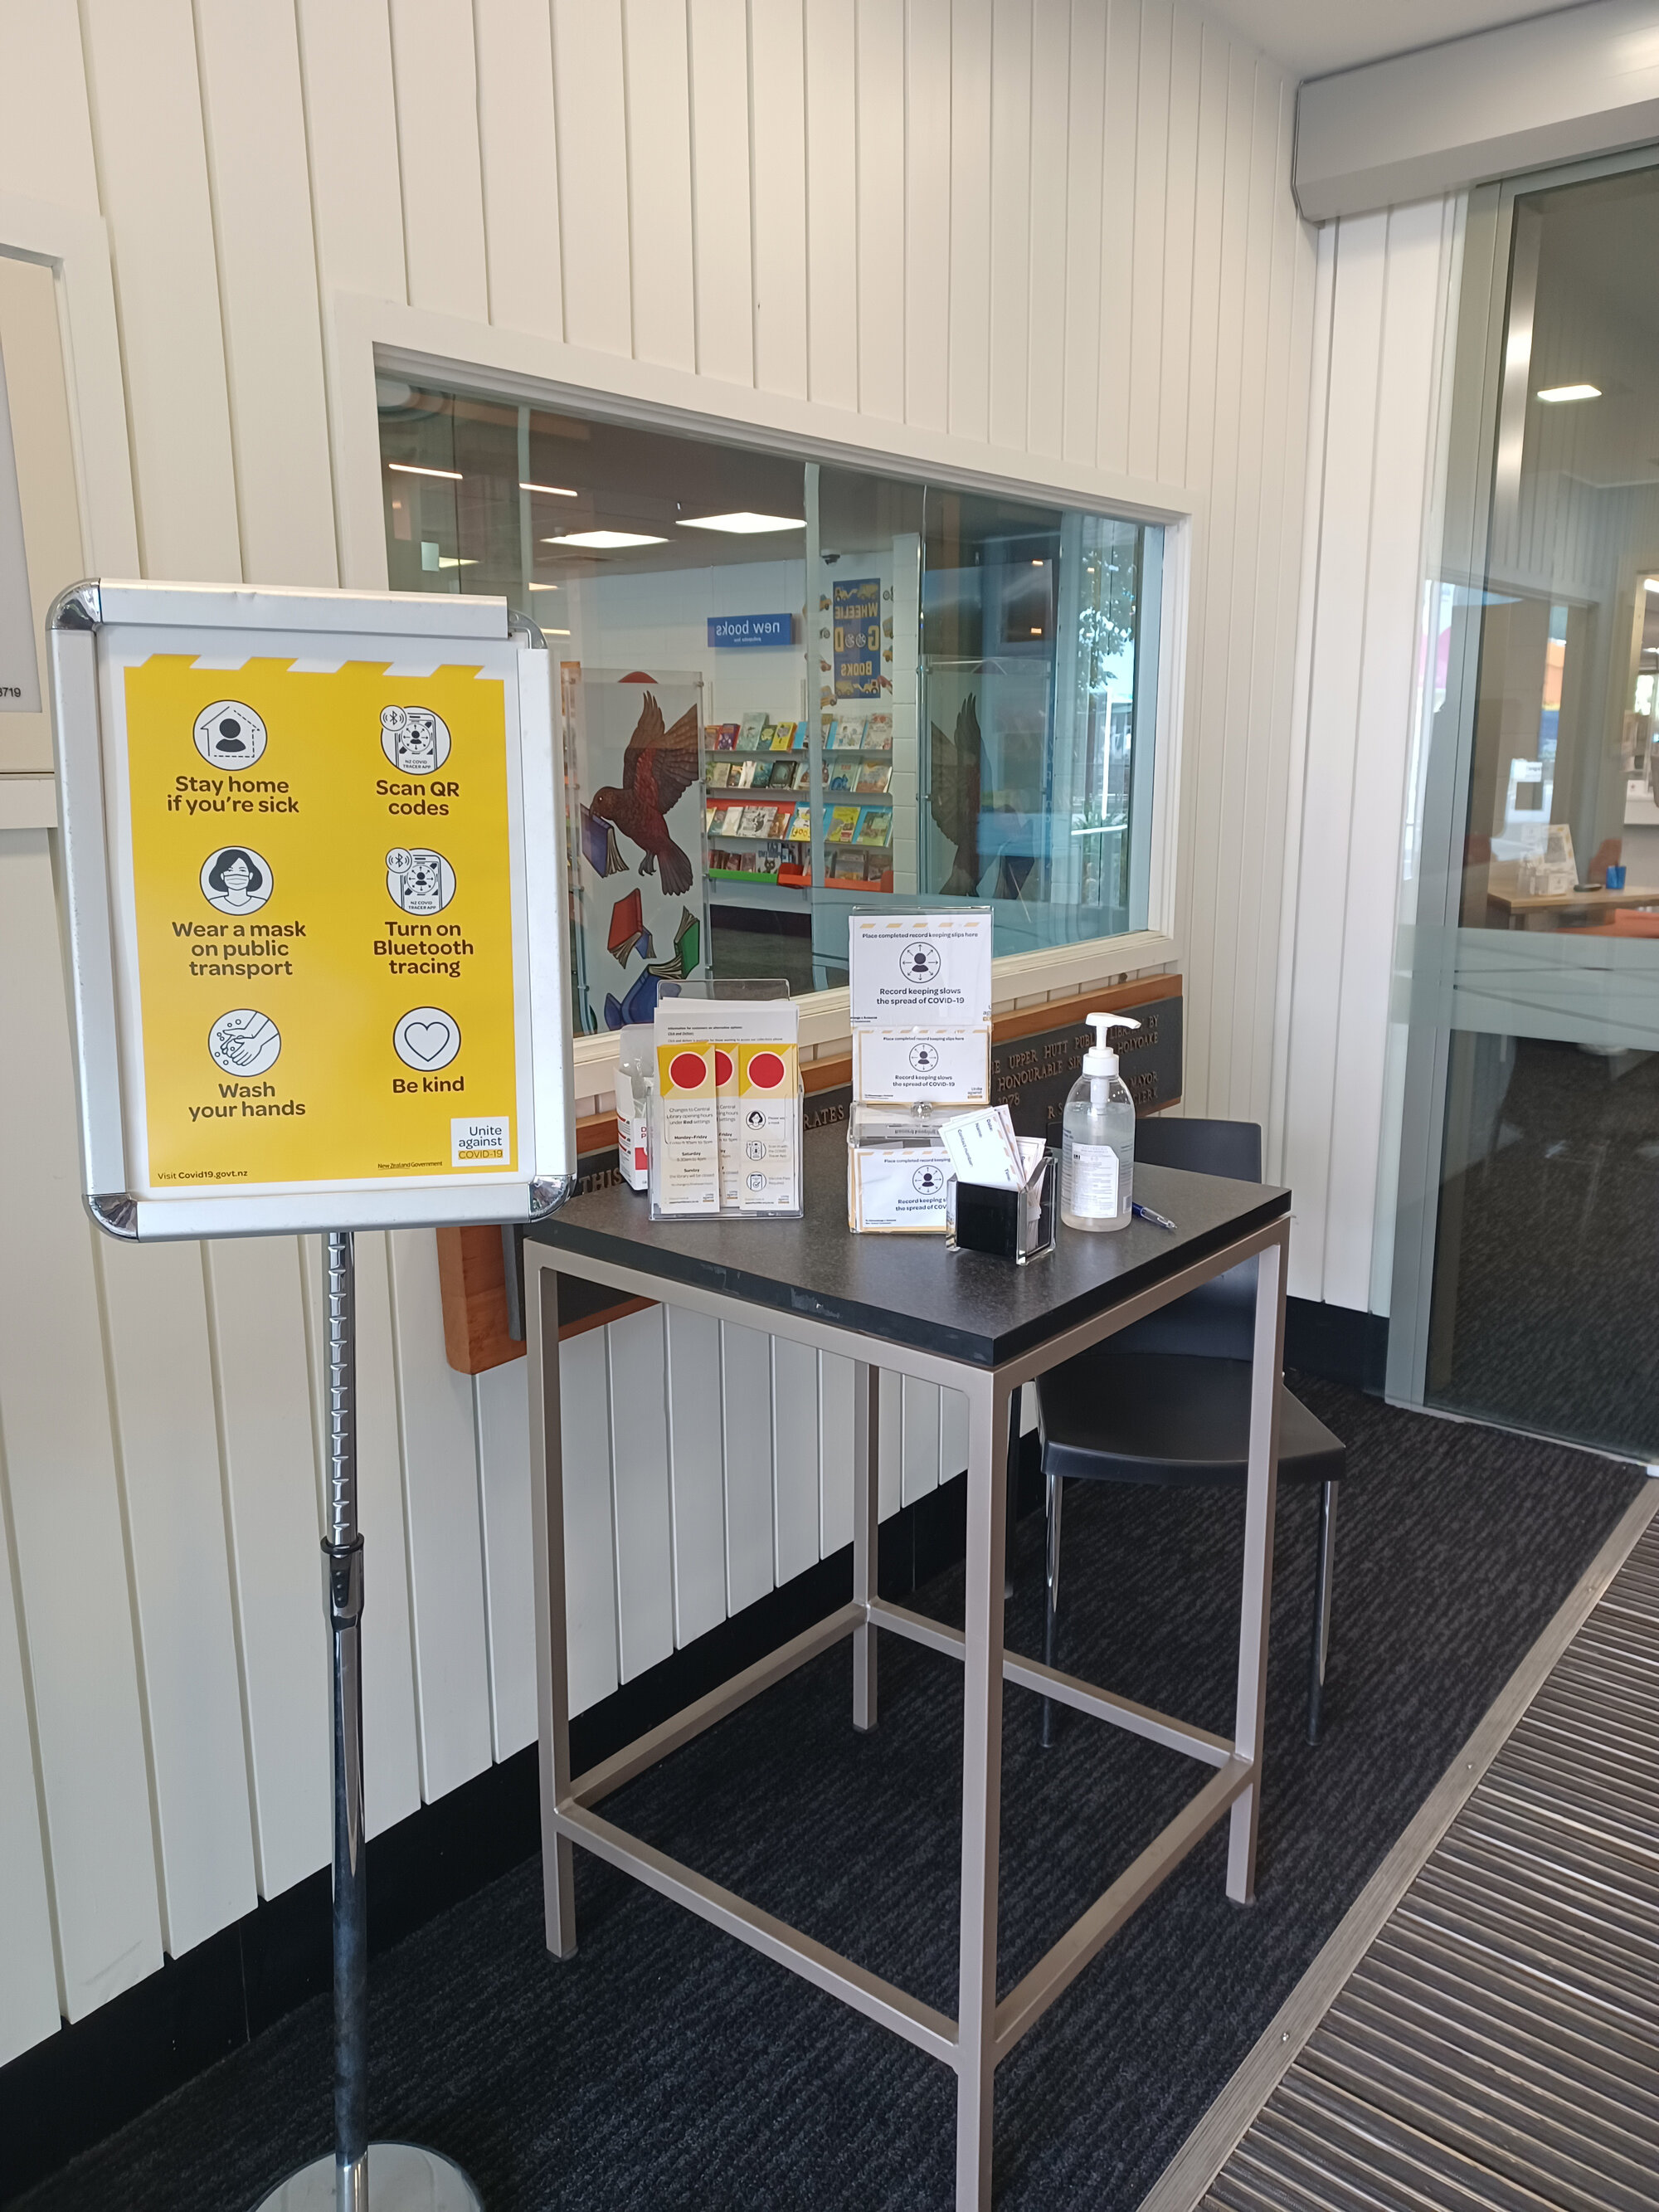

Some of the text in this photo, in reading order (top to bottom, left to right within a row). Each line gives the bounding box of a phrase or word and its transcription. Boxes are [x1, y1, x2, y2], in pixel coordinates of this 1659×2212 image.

[175, 775, 289, 797] Stay home
[376, 779, 460, 797] Scan QR
[167, 794, 299, 816] if you're sick
[388, 799, 450, 816] codes
[172, 920, 306, 938] Wear a mask
[384, 921, 461, 937] Turn on
[191, 939, 289, 961] on public
[373, 938, 474, 955] Bluetooth
[188, 960, 293, 980] transport
[388, 957, 461, 978] tracing
[908, 987, 939, 996] keeping
[890, 997, 917, 1006] spread
[997, 1060, 1063, 1092] HONOURABLE
[1068, 1055, 1082, 1070] SIR
[1117, 1031, 1159, 1055] HOLYOAKE
[392, 1075, 465, 1094] Be kind
[1130, 1071, 1159, 1088] MAYOR
[218, 1081, 275, 1099] Wash
[187, 1099, 306, 1123] your hands
[578, 1167, 624, 1195] THIS
[803, 1104, 844, 1129] RATES
[1009, 1050, 1039, 1069] UPPER
[1044, 1040, 1068, 1060] HUTT
[1075, 1032, 1095, 1050] PUBL
[1148, 1015, 1160, 1029] BY
[469, 1125, 502, 1137] Unite
[957, 1128, 967, 1148] Contact
[458, 1136, 503, 1150] against
[458, 1149, 504, 1160] COVID-19
[157, 1170, 248, 1180] Visit Covid19.govt.nz
